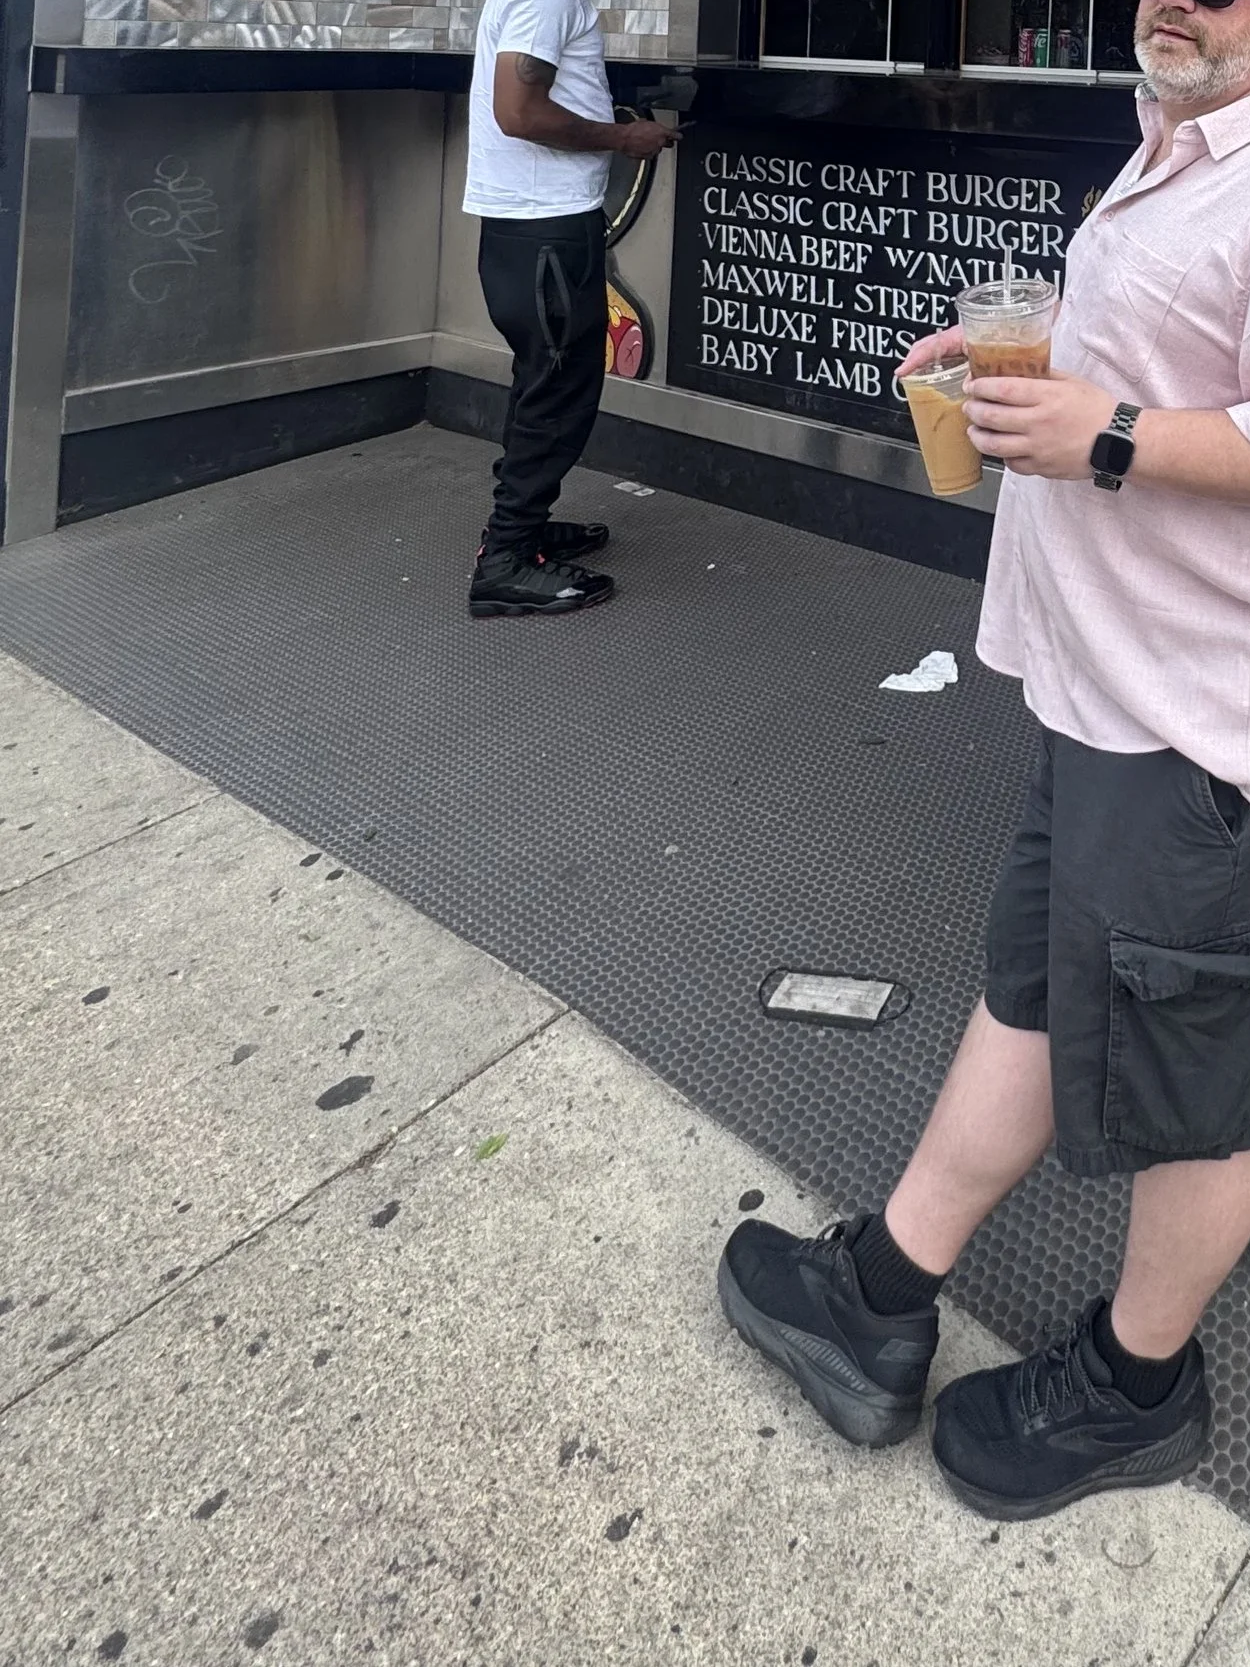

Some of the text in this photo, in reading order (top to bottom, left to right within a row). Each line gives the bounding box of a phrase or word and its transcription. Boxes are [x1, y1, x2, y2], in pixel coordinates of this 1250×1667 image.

[704, 151, 1066, 215] CLASSIC CRAFT BURGER
[702, 222, 797, 263] VIENNA
[800, 235, 872, 273] BEEF
[703, 187, 1067, 258] CLASSIC CRAFT BURGER
[701, 259, 957, 326] MAXWELL STREE
[702, 296, 917, 361] DELUXE FRIES
[701, 334, 779, 375] BABY
[796, 351, 881, 396] LAMB
